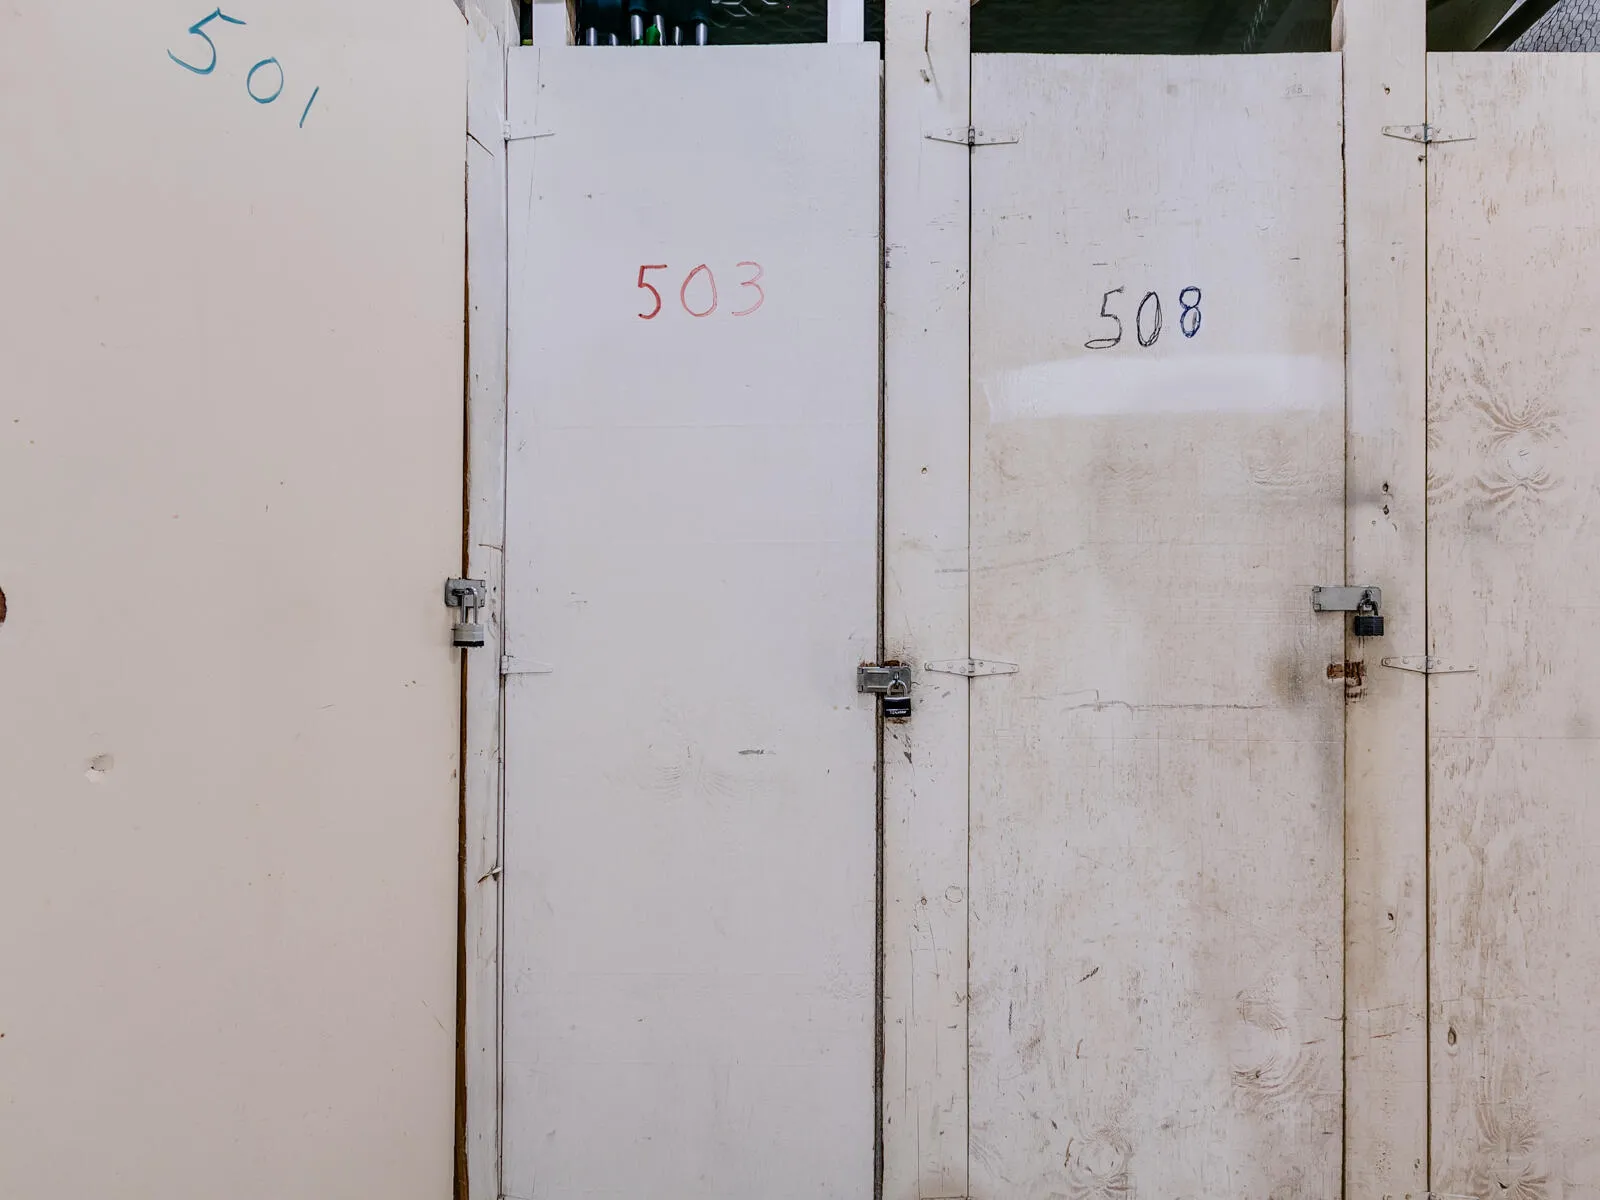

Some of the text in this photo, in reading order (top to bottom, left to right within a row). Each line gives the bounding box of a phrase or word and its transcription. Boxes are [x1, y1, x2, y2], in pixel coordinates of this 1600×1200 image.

[167, 7, 319, 128] 501
[638, 261, 764, 319] 503
[1084, 286, 1201, 349] 508
